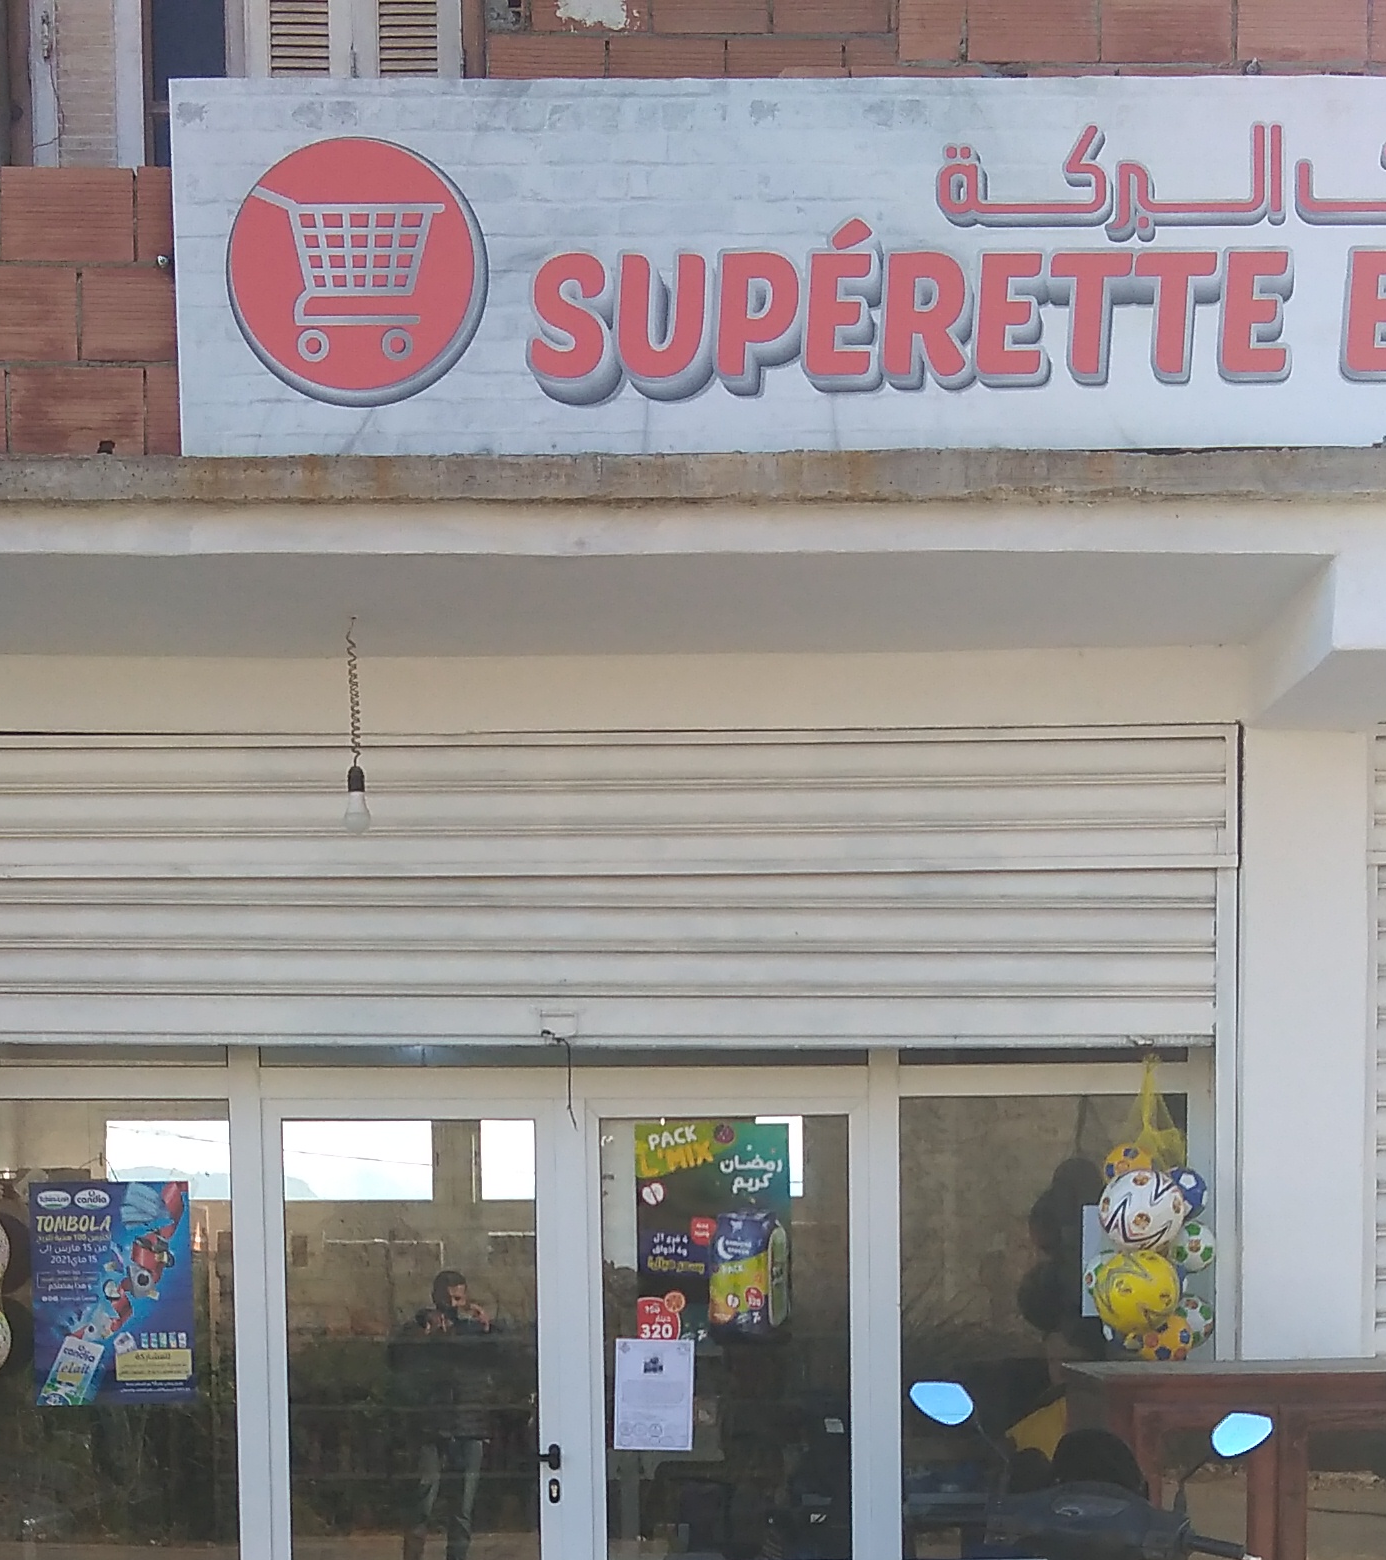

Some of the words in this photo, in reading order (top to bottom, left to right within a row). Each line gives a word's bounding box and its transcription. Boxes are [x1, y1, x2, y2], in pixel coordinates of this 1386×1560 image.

[935, 120, 1287, 242] البركة
[527, 216, 1294, 404] SUPÉRETTE
[648, 1124, 698, 1150] PACK
[719, 1152, 783, 1174] رمضان
[732, 1172, 774, 1195] كريم
[77, 1193, 107, 1204] candia
[36, 1215, 111, 1233] TOMBOLA
[73, 1233, 87, 1242] 100
[82, 1243, 92, 1252] 15
[50, 1255, 70, 1264] 2021
[88, 1255, 98, 1264] 15
[640, 1323, 673, 1339] 320
